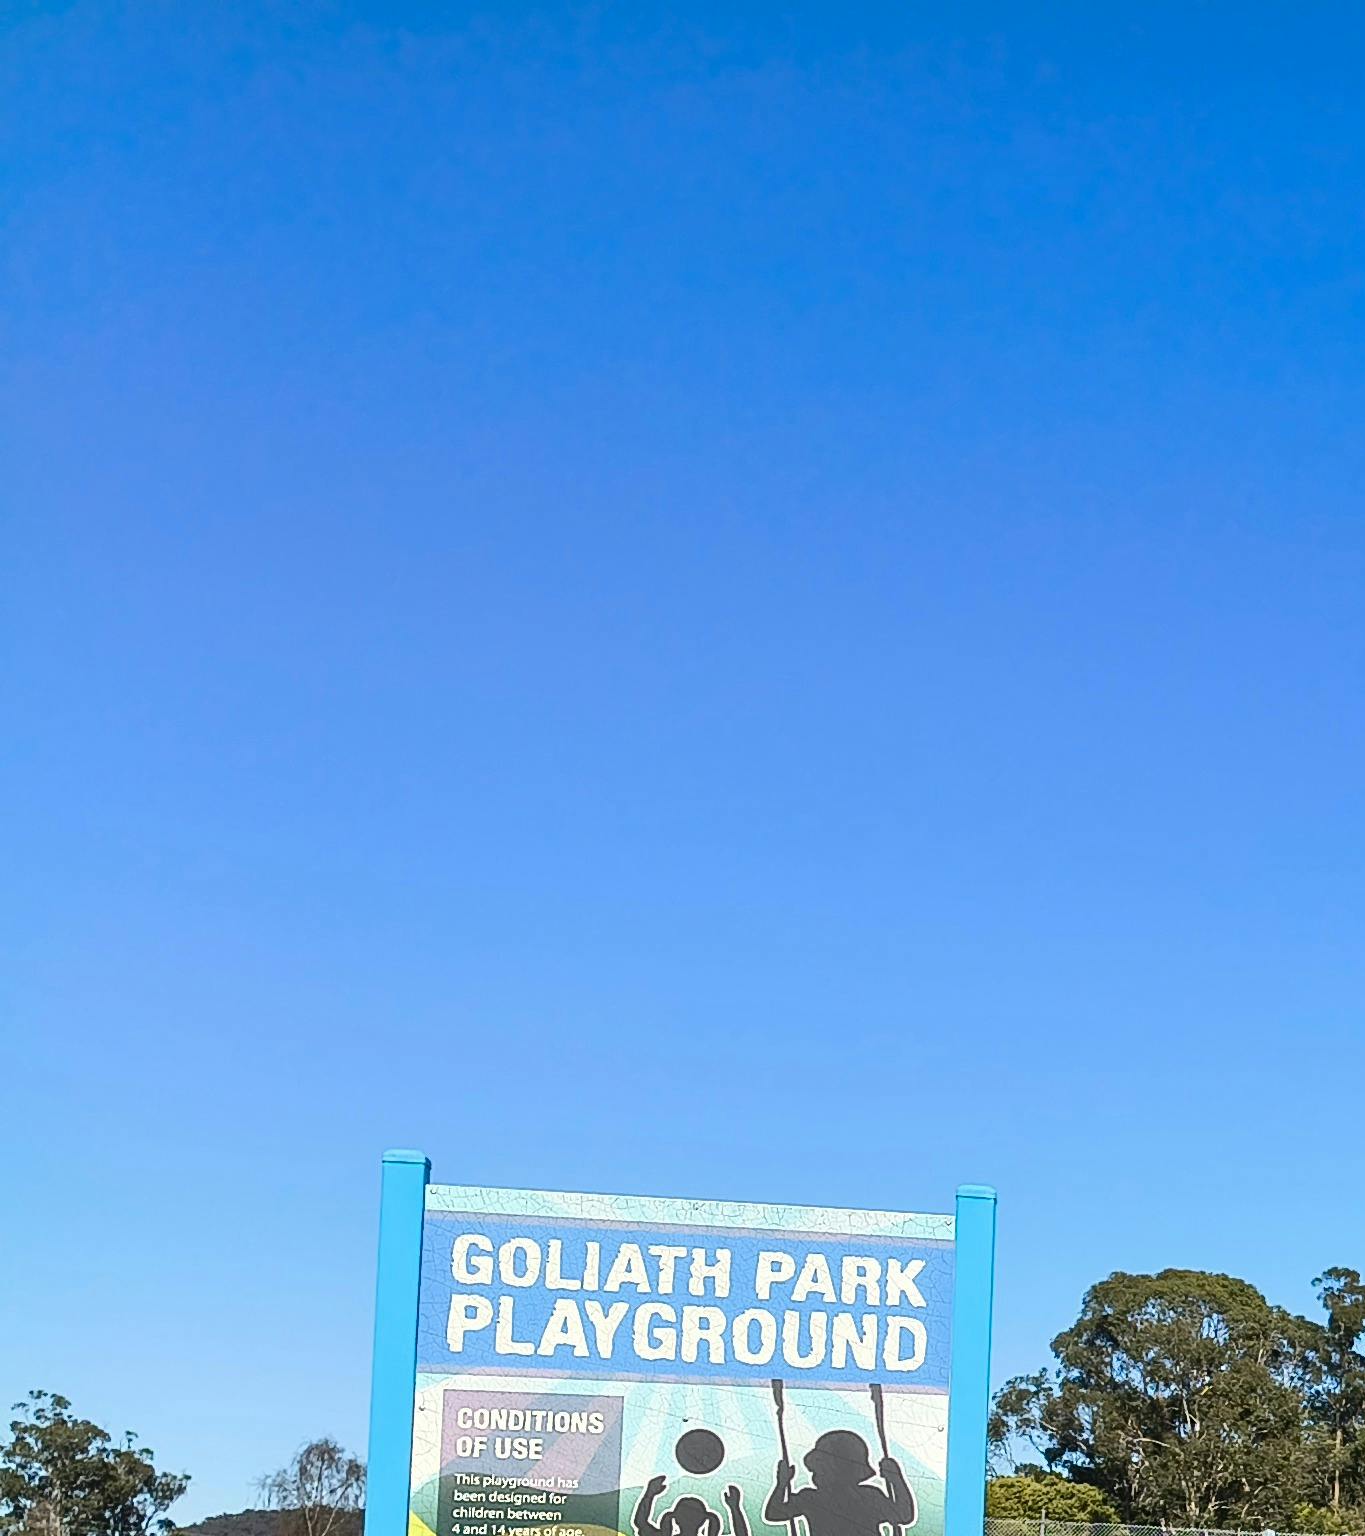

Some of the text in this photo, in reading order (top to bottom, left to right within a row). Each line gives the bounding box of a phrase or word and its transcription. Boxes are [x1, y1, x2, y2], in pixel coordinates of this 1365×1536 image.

[451, 1233, 927, 1309] GOLIATH PARK
[446, 1293, 928, 1373] PLAYGROUND
[457, 1407, 604, 1435] CONDITIONS
[456, 1436, 543, 1461] OF USE
[454, 1474, 579, 1488] This playground has
[454, 1490, 567, 1505] been designed for
[452, 1507, 561, 1520] children between
[452, 1524, 460, 1535] 4
[463, 1524, 487, 1535] and
[491, 1525, 505, 1535] 14
[544, 1526, 557, 1536] of
